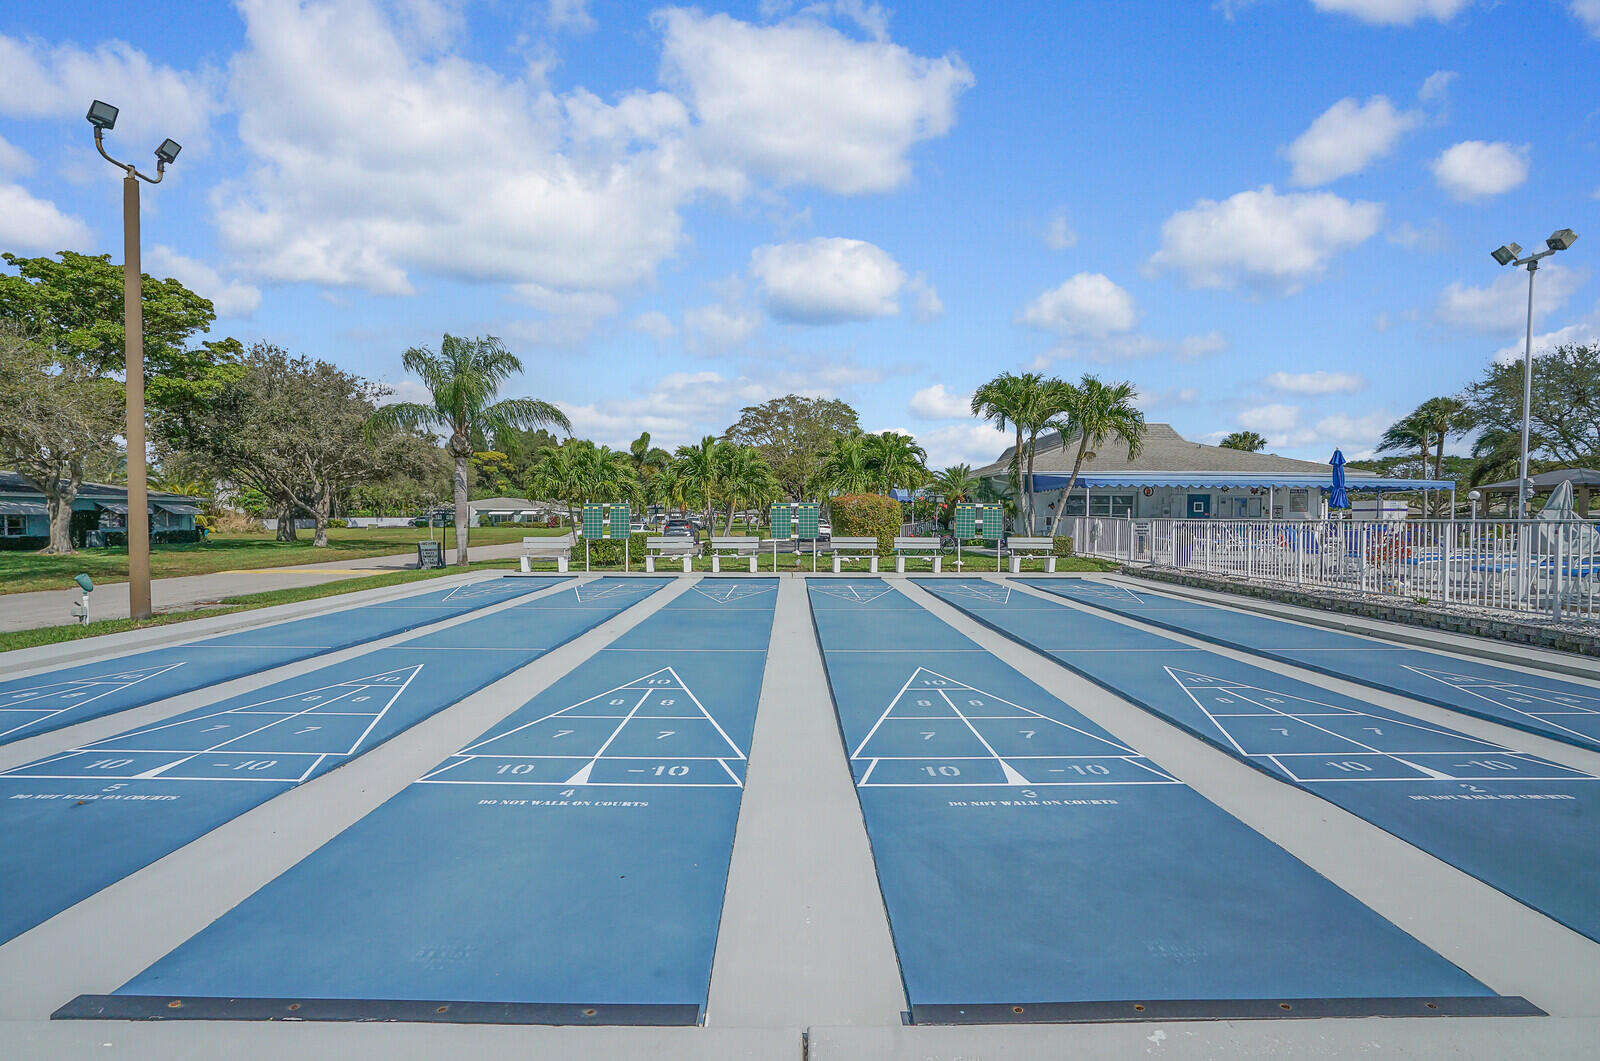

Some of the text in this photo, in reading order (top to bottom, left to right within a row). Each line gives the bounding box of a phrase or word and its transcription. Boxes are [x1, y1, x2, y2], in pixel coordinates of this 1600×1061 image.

[1186, 675, 1213, 683] 10
[608, 698, 625, 706] 8
[916, 699, 932, 707] 8
[967, 699, 985, 707] 8
[199, 724, 230, 733] 7
[294, 726, 323, 735] 7
[1271, 727, 1289, 737] 7
[1362, 727, 1383, 736] 7
[552, 729, 574, 738] 7
[657, 730, 676, 740] 7
[919, 731, 936, 740] 7
[1018, 730, 1036, 739] 7
[84, 758, 135, 769] 10
[1325, 761, 1373, 772] 10
[496, 764, 535, 775] 10
[920, 765, 961, 777] 10
[101, 783, 129, 792] 5
[1459, 783, 1487, 793] 2
[559, 788, 575, 798] 4
[1021, 789, 1038, 799] 3
